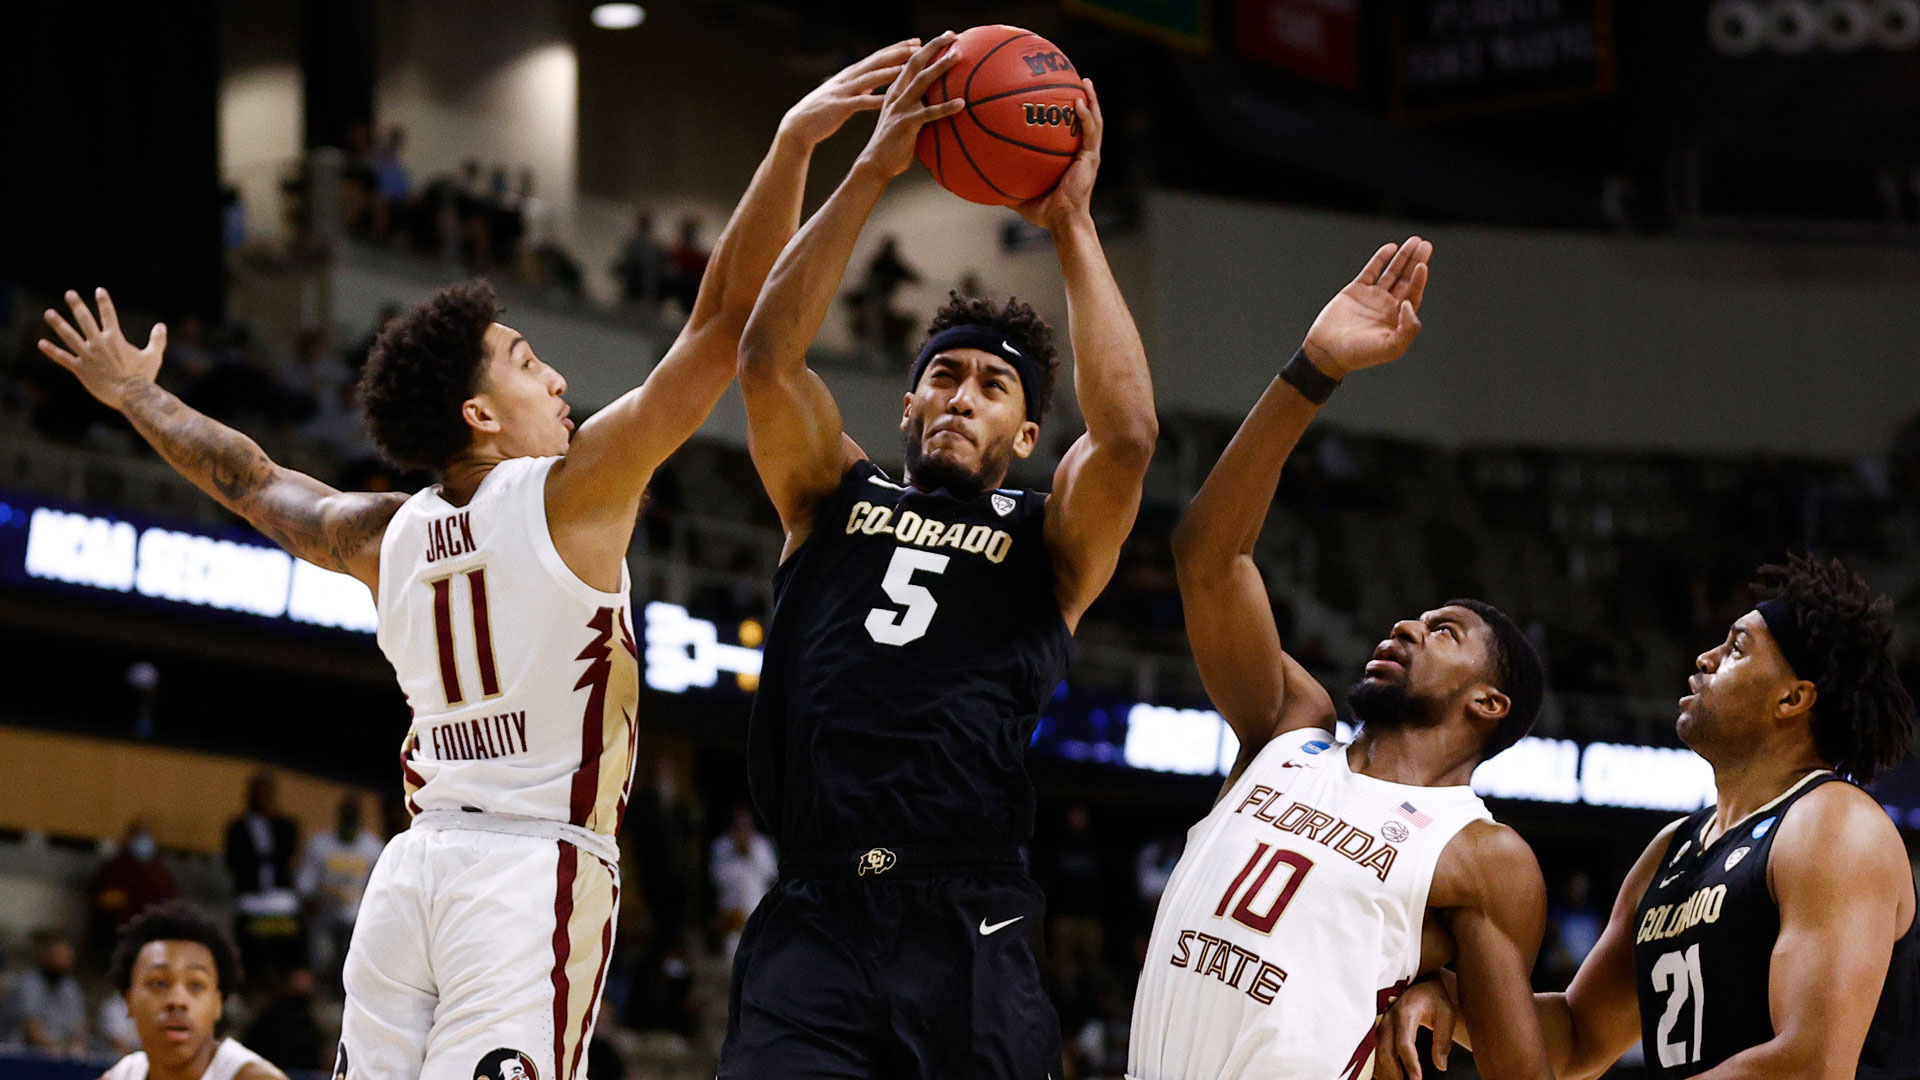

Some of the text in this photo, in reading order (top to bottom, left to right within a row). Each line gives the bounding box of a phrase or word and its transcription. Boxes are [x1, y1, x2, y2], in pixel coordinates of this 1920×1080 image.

[426, 511, 477, 563] JACK
[846, 501, 1013, 564] COLORADO
[422, 565, 502, 708] 11
[864, 546, 950, 646] 5
[432, 711, 528, 760] EQUALITY
[1234, 785, 1402, 883] FLORIDA
[1212, 838, 1316, 937] 10
[1170, 930, 1288, 1005] STATE
[1651, 943, 1704, 1068] 21
